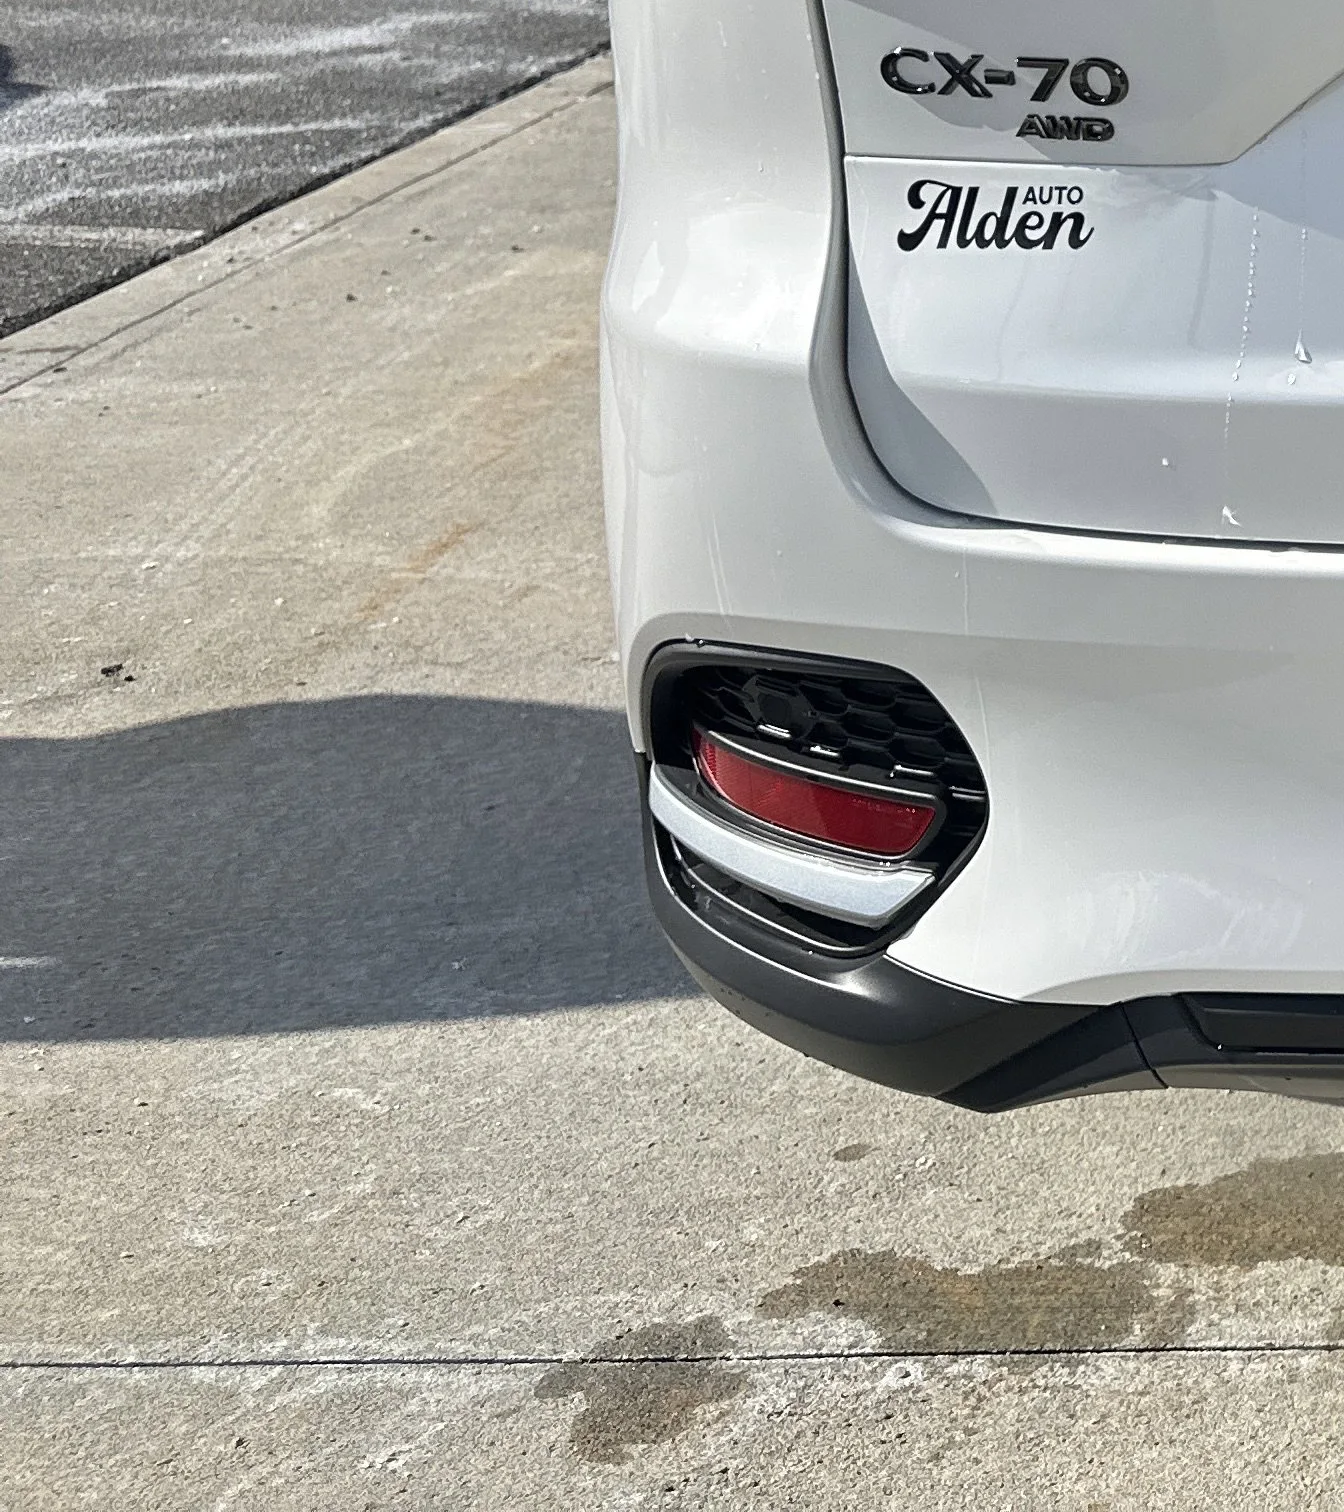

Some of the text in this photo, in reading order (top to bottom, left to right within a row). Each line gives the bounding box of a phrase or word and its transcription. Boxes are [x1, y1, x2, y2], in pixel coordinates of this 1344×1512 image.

[880, 46, 1129, 107] CX-70
[1016, 114, 1115, 141] AWD
[897, 179, 1094, 251] Alden
[1022, 186, 1083, 205] AUTO
